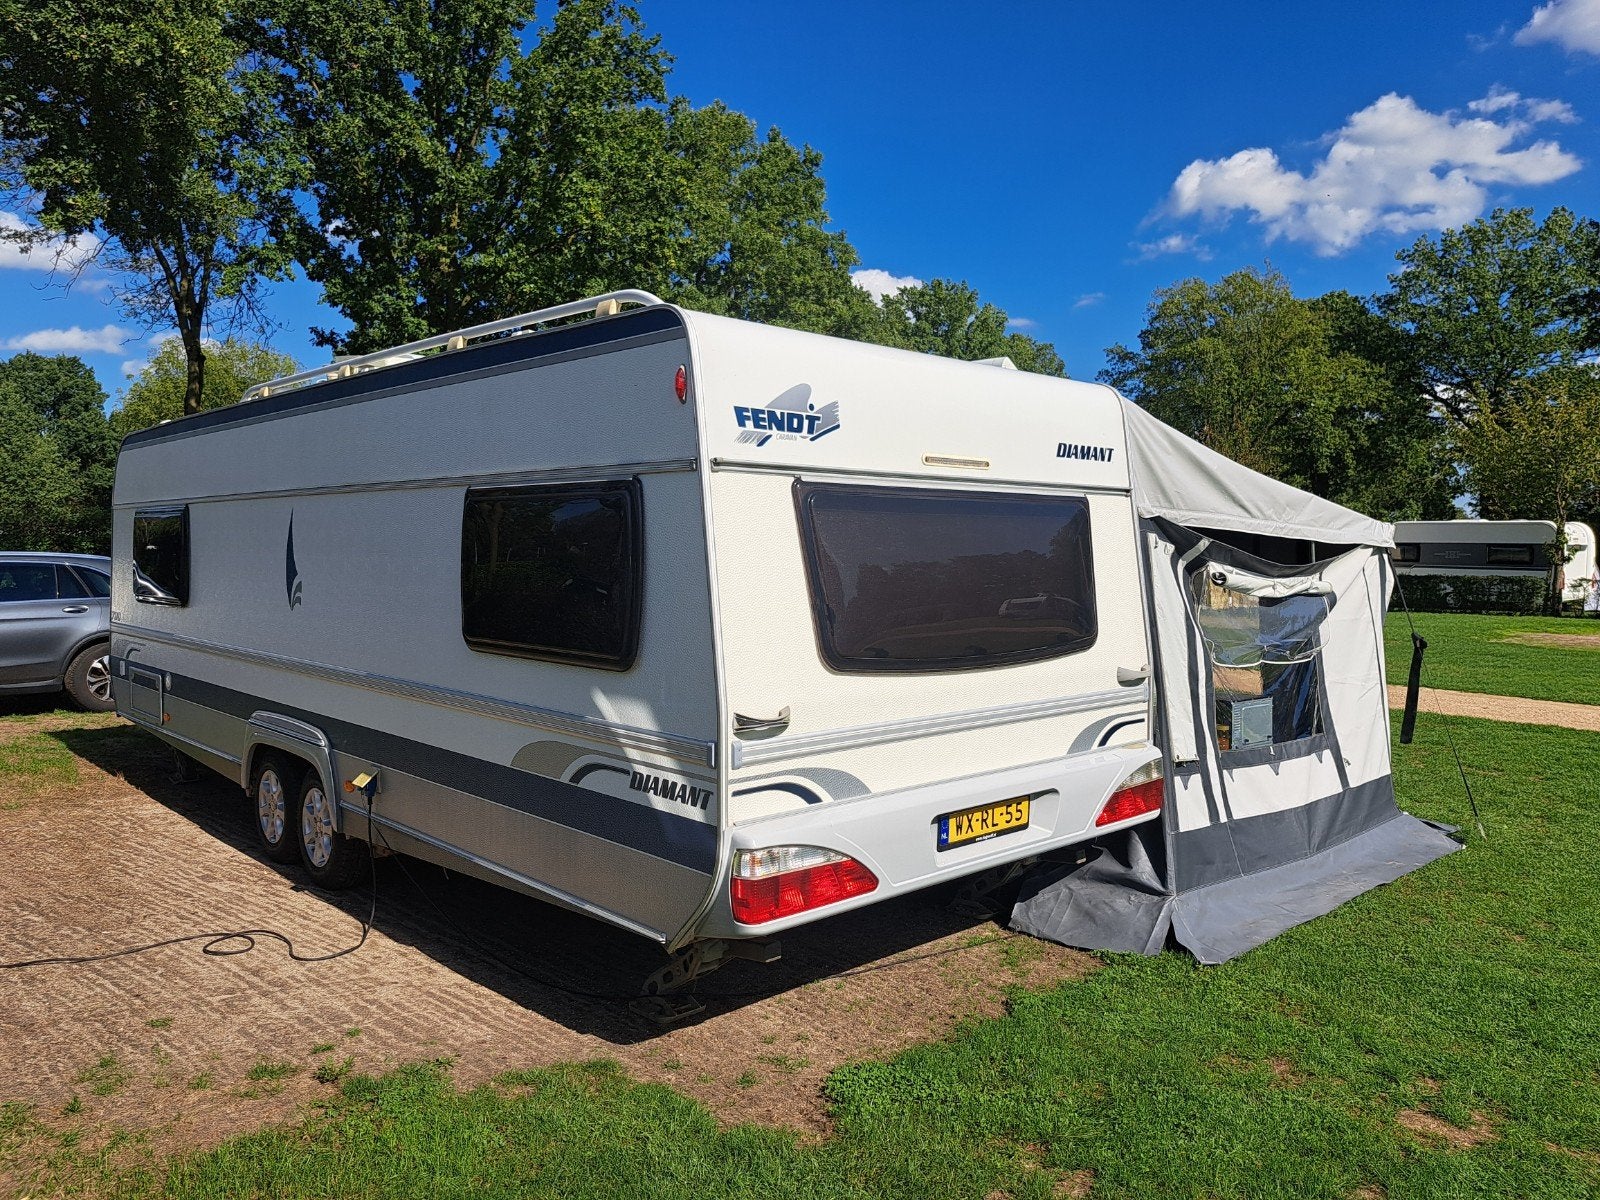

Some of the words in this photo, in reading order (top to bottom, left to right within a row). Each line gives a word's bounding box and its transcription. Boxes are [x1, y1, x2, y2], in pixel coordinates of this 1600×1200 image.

[733, 405, 821, 435] FENDT
[1056, 442, 1114, 462] DIAMANT
[629, 770, 714, 811] DIAMANT
[955, 801, 1023, 837] WX-RL-55
